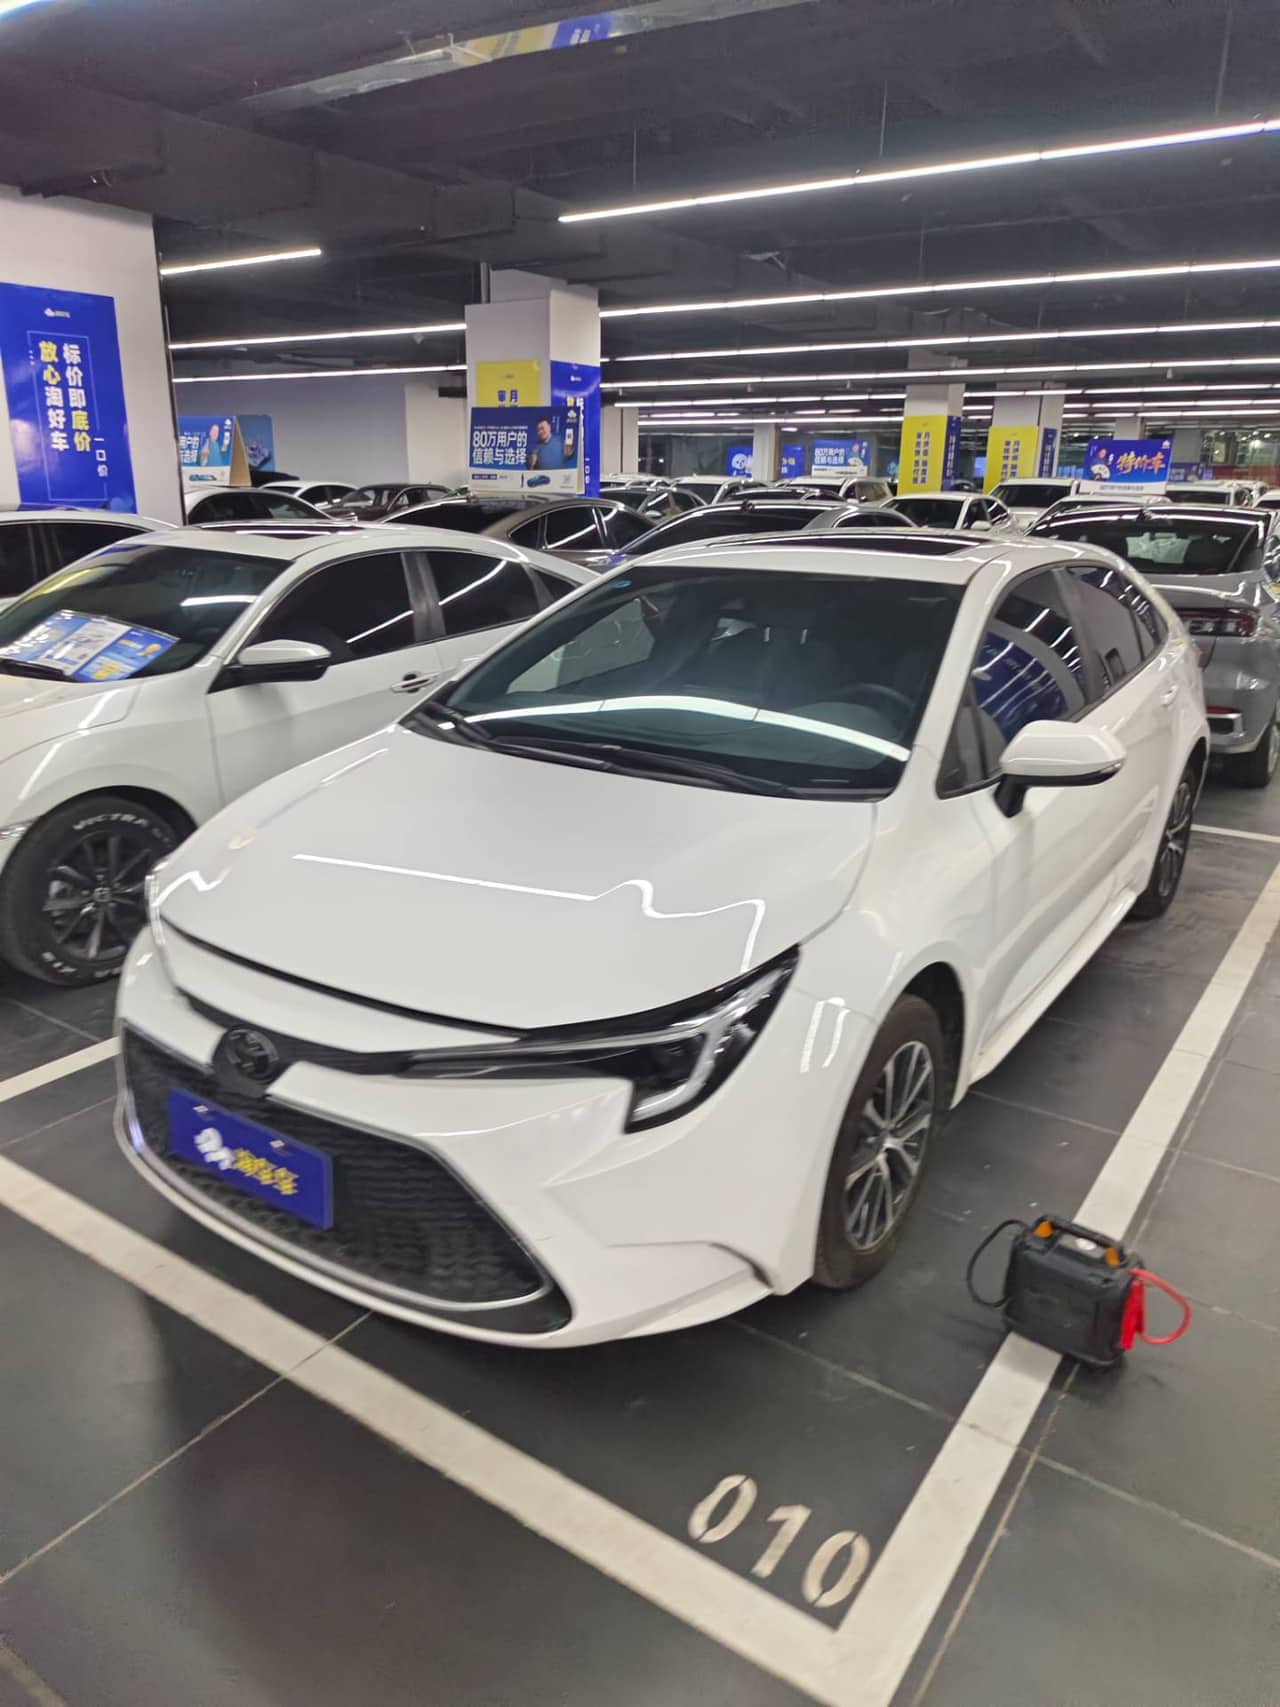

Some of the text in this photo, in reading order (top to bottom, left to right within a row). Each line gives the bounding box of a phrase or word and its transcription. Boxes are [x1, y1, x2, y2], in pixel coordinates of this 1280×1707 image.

[38, 340, 70, 451] 放心淘好车
[62, 343, 91, 452] 标价即底价
[472, 430, 528, 448] 80万用户的
[472, 447, 527, 466] 信赖与选择
[1116, 450, 1166, 476] 特价车
[687, 1474, 871, 1609] 010
